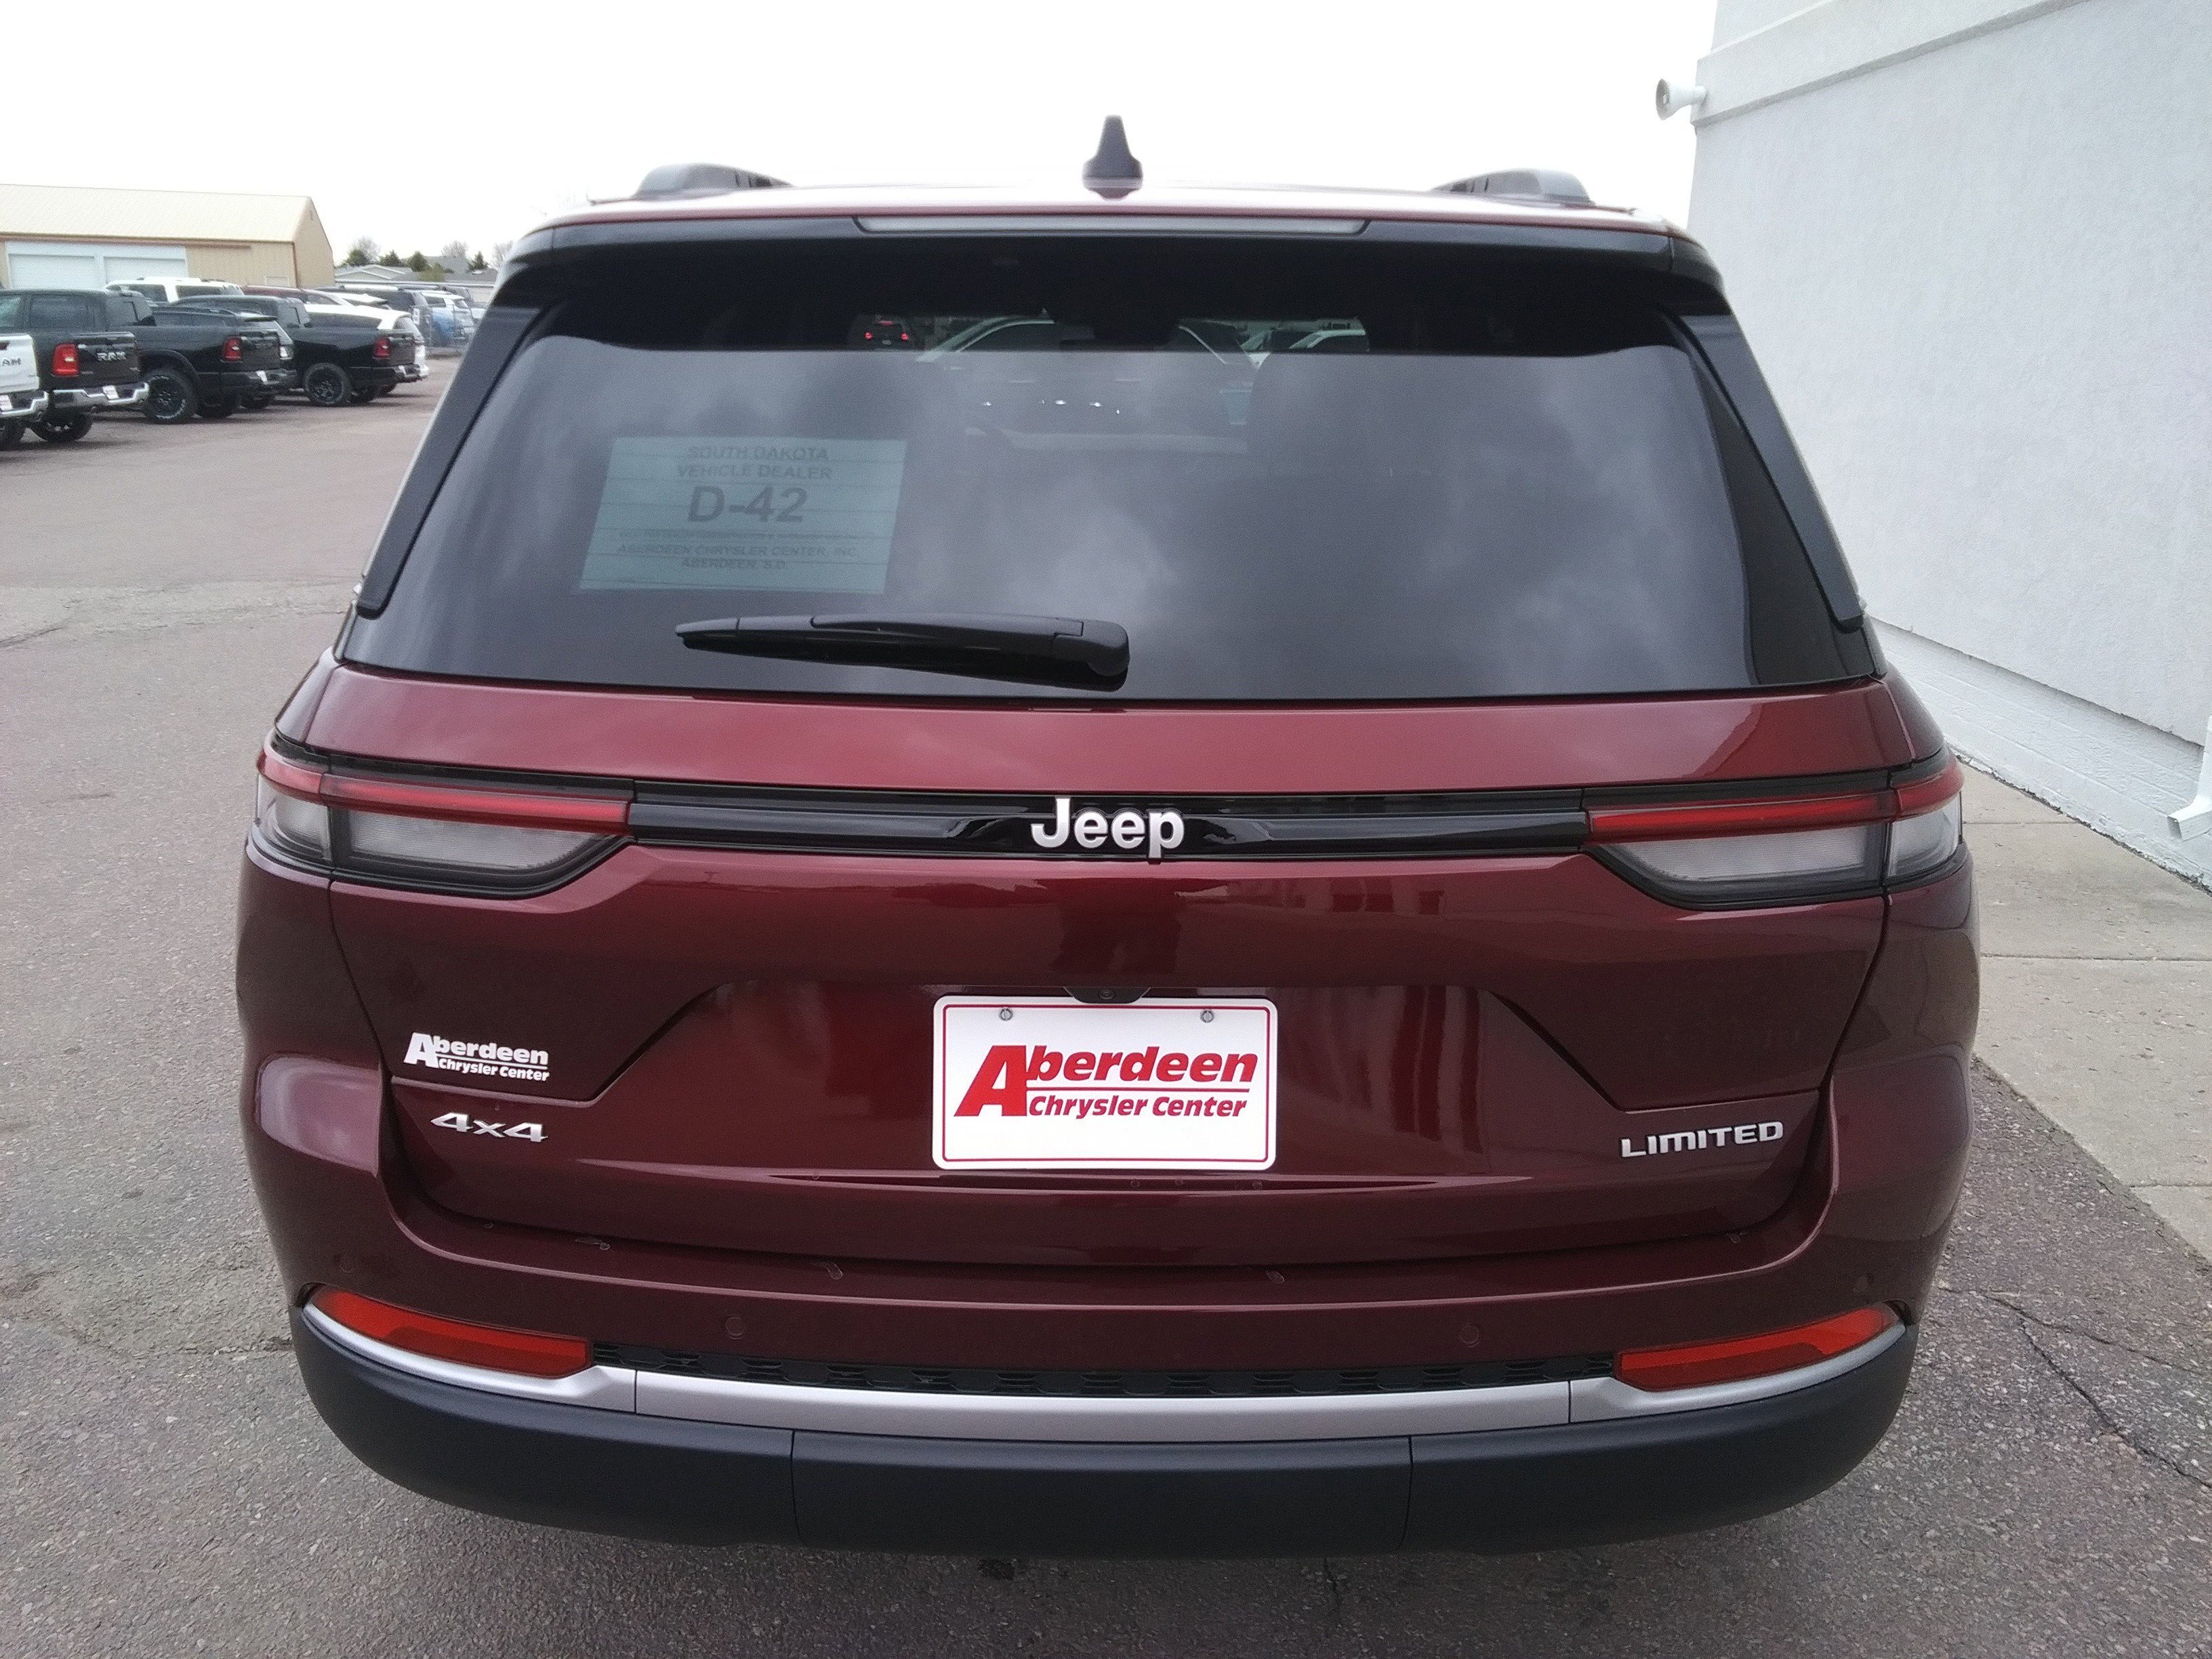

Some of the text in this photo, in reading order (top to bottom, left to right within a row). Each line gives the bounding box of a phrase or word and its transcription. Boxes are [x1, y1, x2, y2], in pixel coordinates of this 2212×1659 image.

[0, 357, 21, 366] AM
[97, 351, 127, 361] RAM
[687, 446, 829, 461] SOUTH DAKOTA
[677, 464, 833, 480] VEHICLE DEALER
[687, 485, 808, 523] D-42
[1031, 798, 1185, 859] Jeep
[403, 1032, 549, 1068] Aberdeen
[438, 1058, 550, 1082] Chrysler Center
[954, 1044, 1258, 1117] Aberdeen
[1029, 1094, 1247, 1120] Chrysler Center
[430, 1112, 549, 1143] 4x4
[1621, 1121, 1784, 1158] LIMITED
